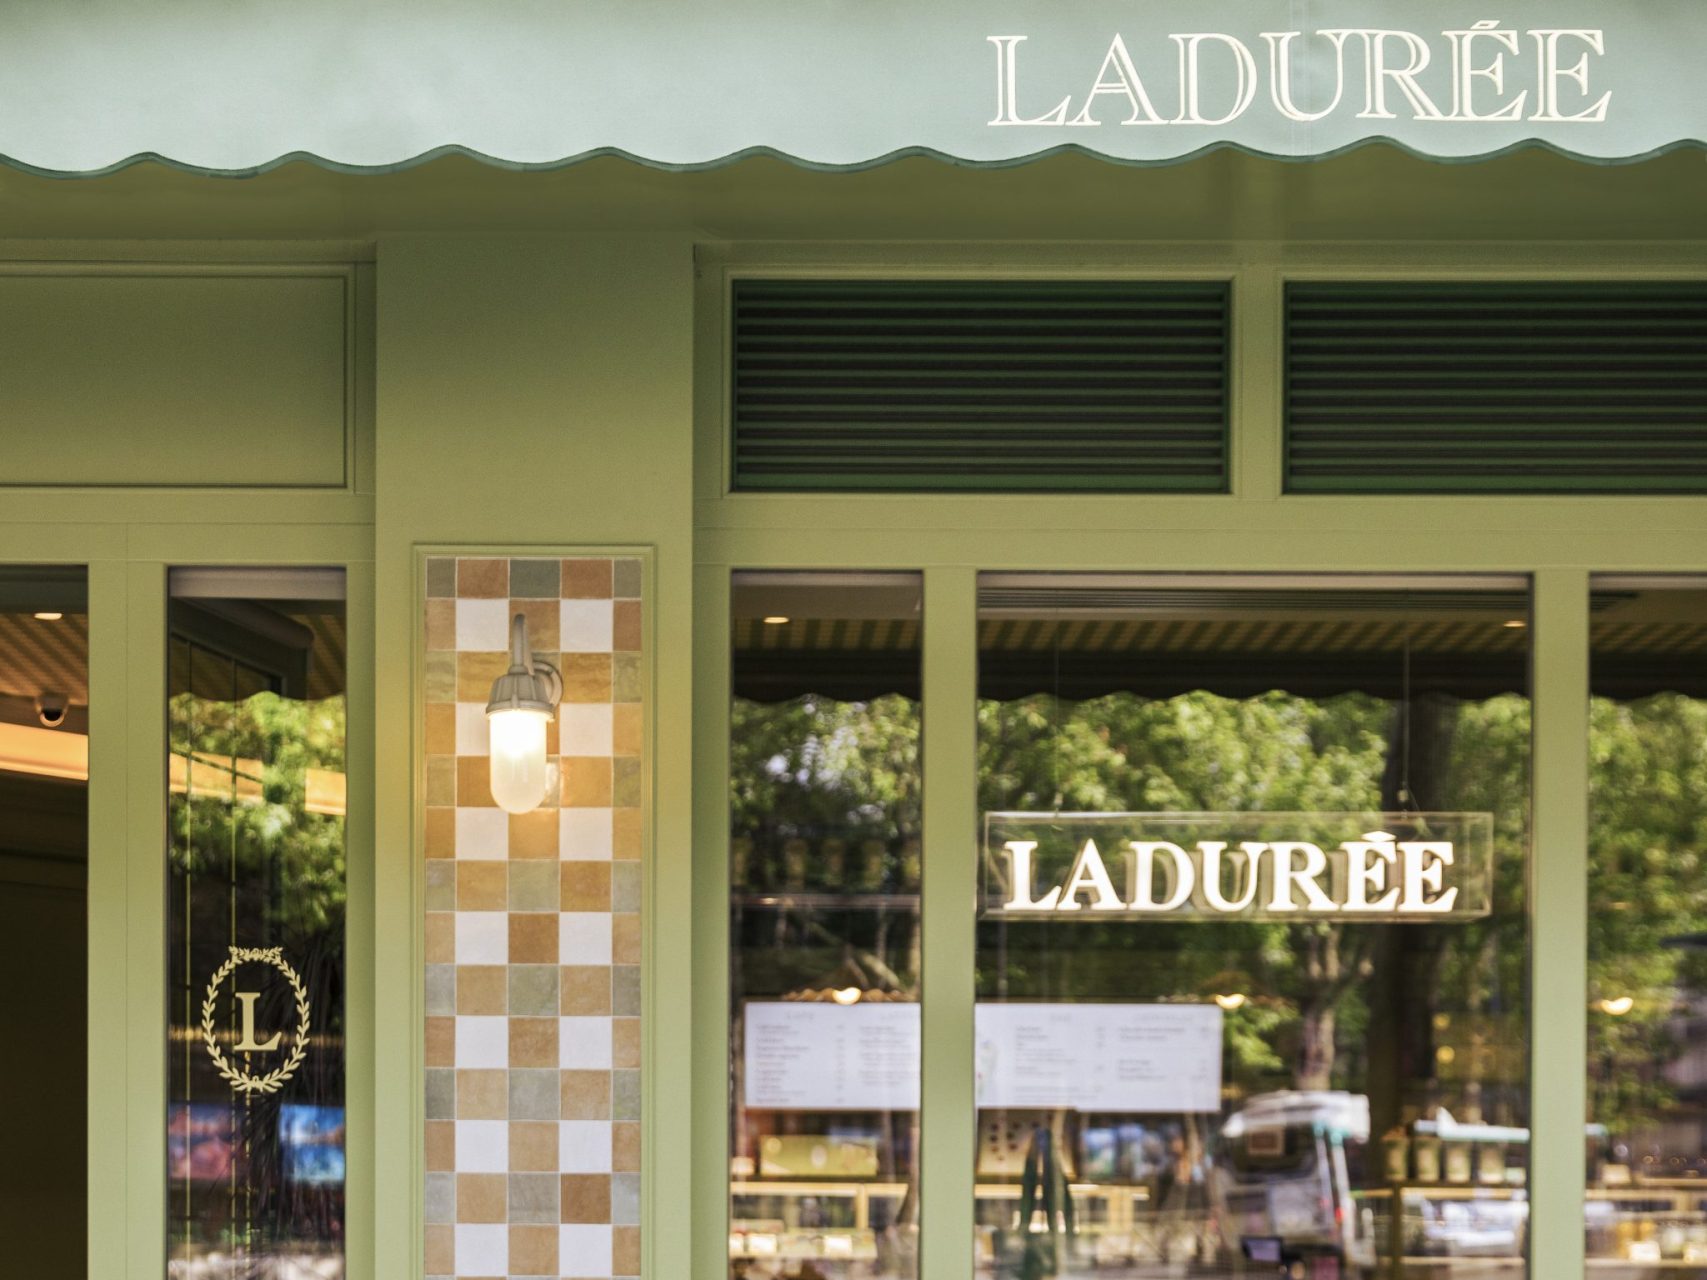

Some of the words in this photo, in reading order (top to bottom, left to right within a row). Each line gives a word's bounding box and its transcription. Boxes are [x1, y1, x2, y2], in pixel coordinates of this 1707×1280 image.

[986, 20, 1613, 127] LADURÉE
[1003, 830, 1459, 913] LADURÉE
[233, 992, 282, 1051] L
